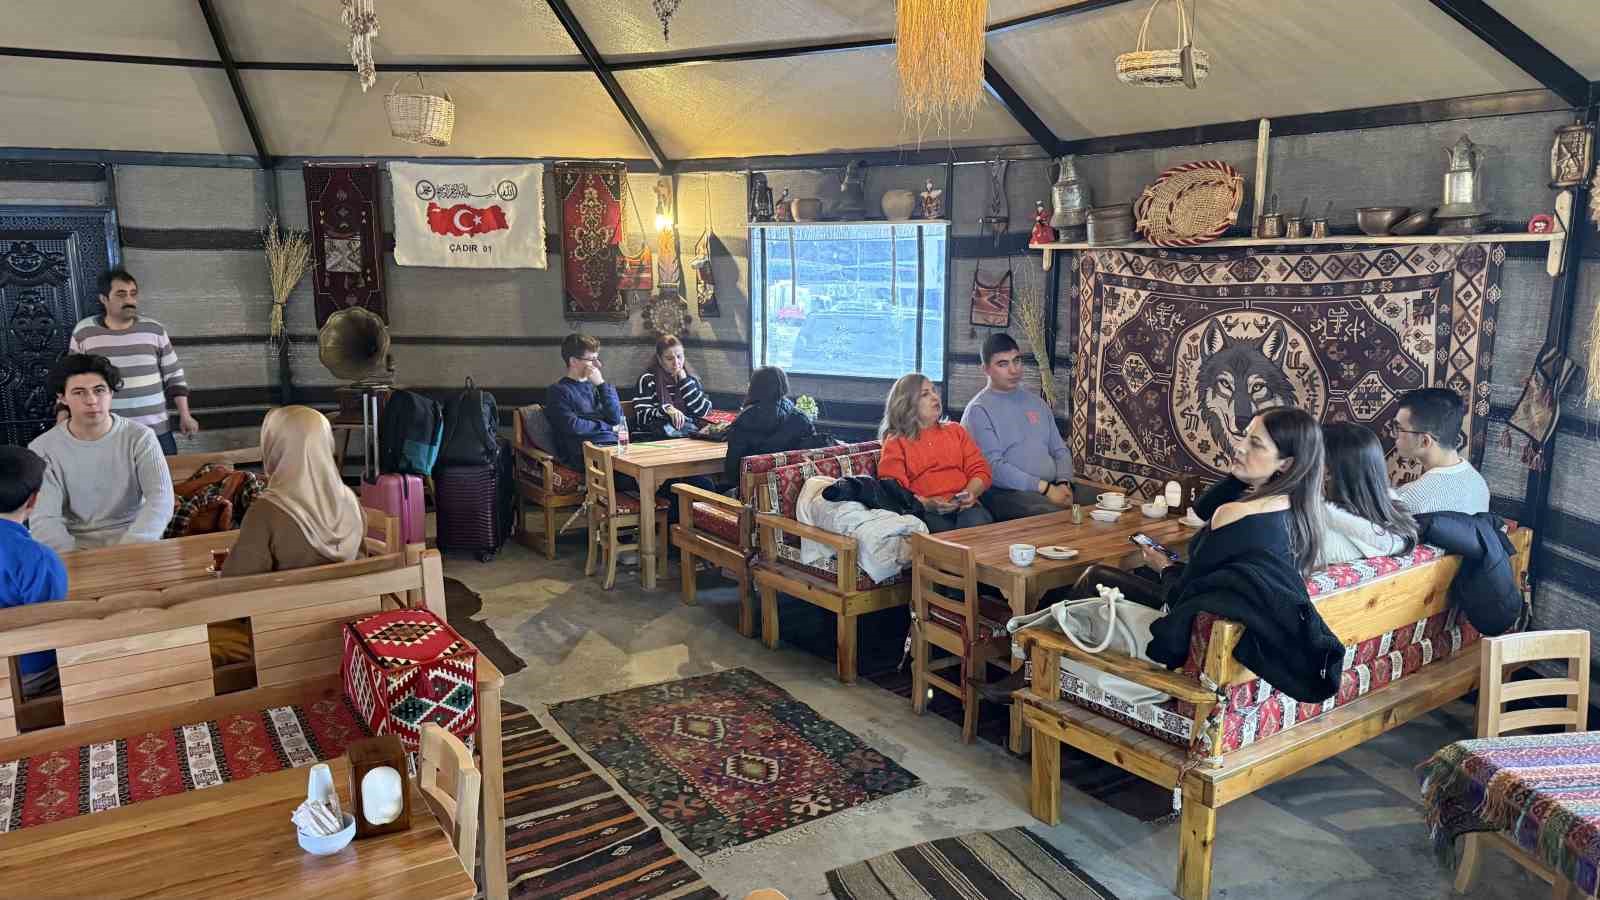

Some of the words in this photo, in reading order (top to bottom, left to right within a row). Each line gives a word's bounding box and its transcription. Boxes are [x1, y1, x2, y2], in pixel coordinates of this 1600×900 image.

[449, 243, 478, 254] ÇADIR
[483, 245, 492, 254] 01
[1190, 487, 1196, 502] 5
